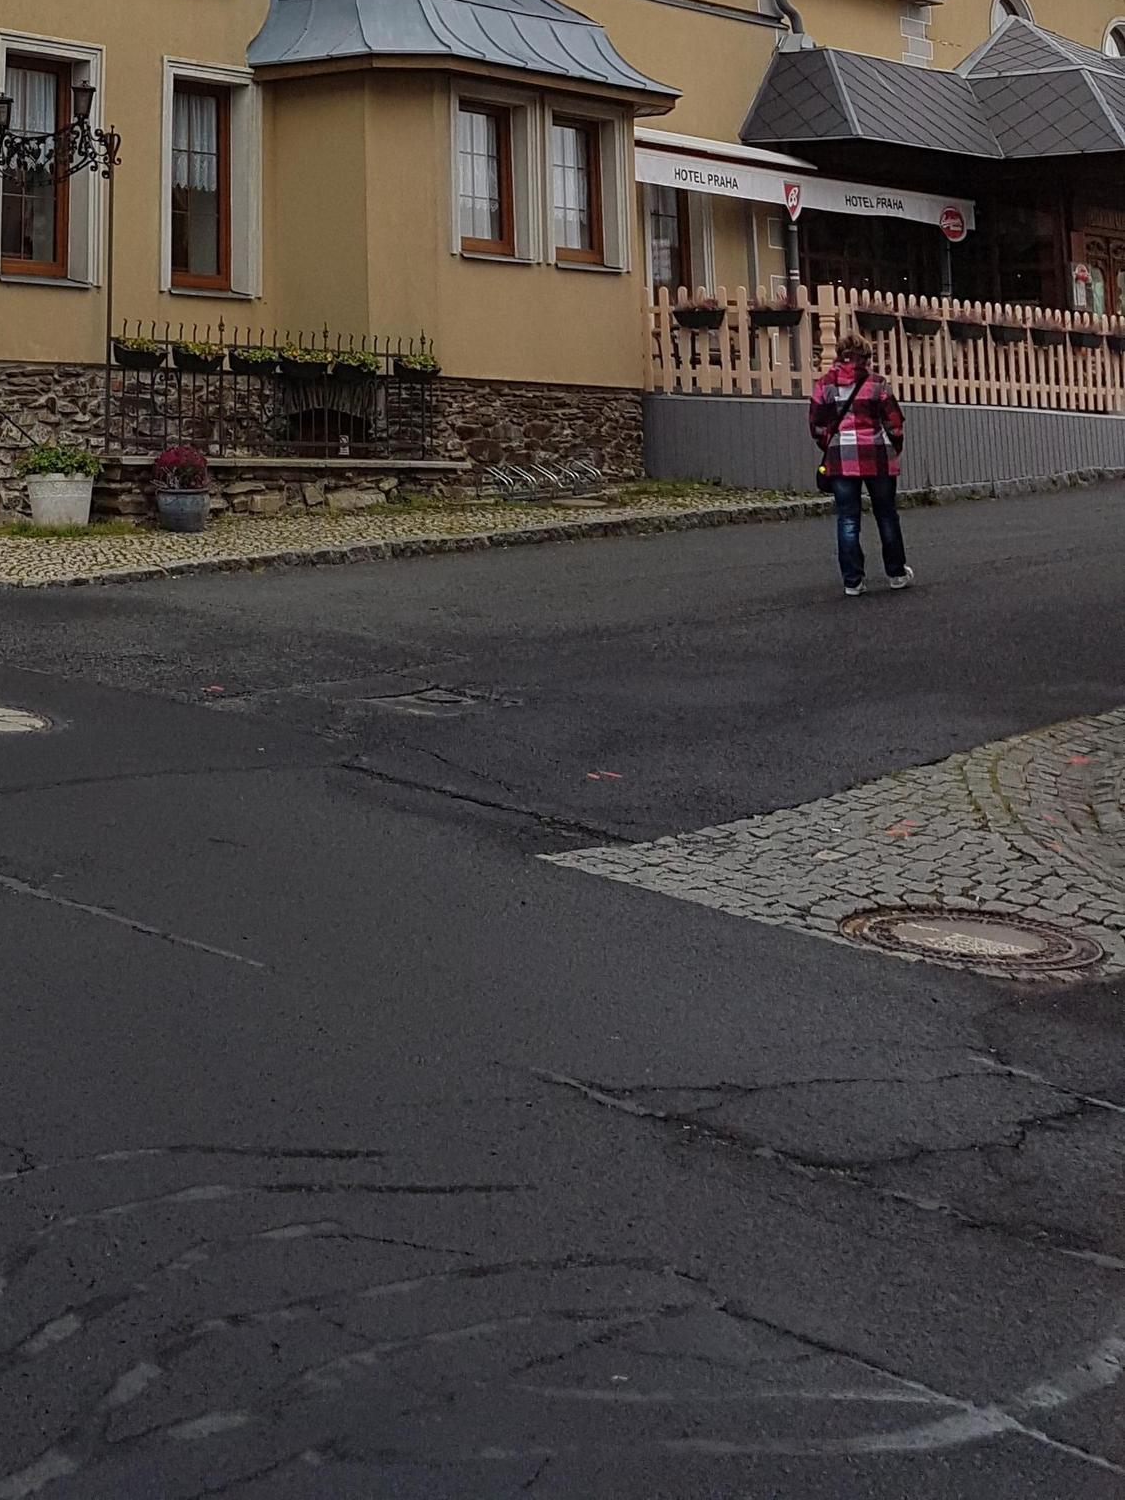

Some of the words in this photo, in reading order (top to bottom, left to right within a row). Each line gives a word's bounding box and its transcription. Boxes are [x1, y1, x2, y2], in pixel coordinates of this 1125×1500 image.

[674, 167, 705, 185] HOTEL
[707, 173, 739, 190] PRAHA
[844, 194, 875, 209] HOTEL
[876, 197, 904, 212] PRAHA
